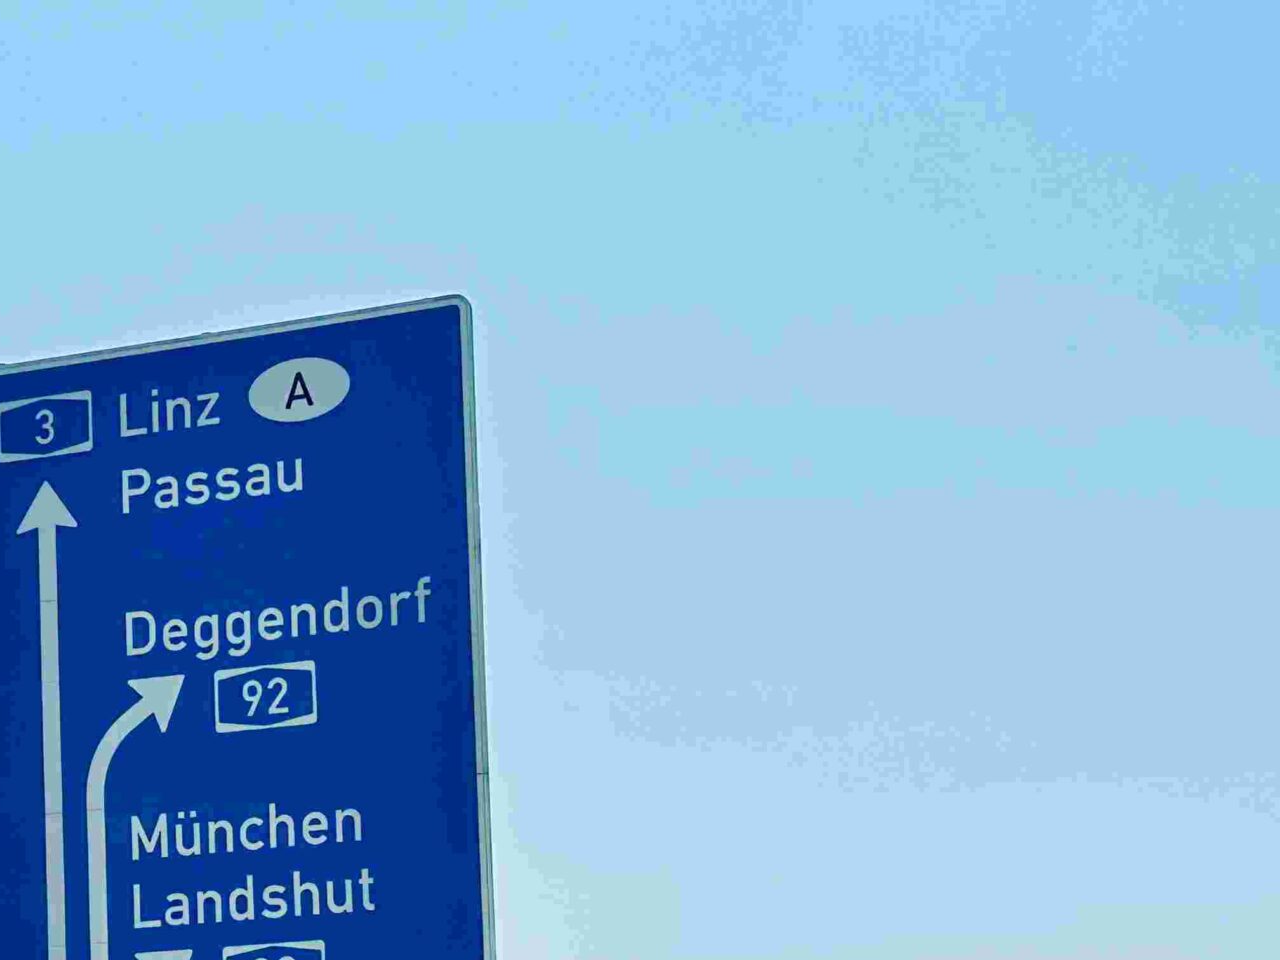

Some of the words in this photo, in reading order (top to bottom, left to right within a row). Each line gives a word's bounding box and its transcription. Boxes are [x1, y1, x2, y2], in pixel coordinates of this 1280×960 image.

[120, 389, 220, 437] Linz
[285, 371, 314, 409] A
[34, 409, 55, 445] 3
[122, 458, 304, 514] Passau
[125, 577, 431, 660] Deggendorf
[242, 677, 289, 717] 92
[131, 803, 362, 860] München
[133, 868, 376, 928] Landshut
